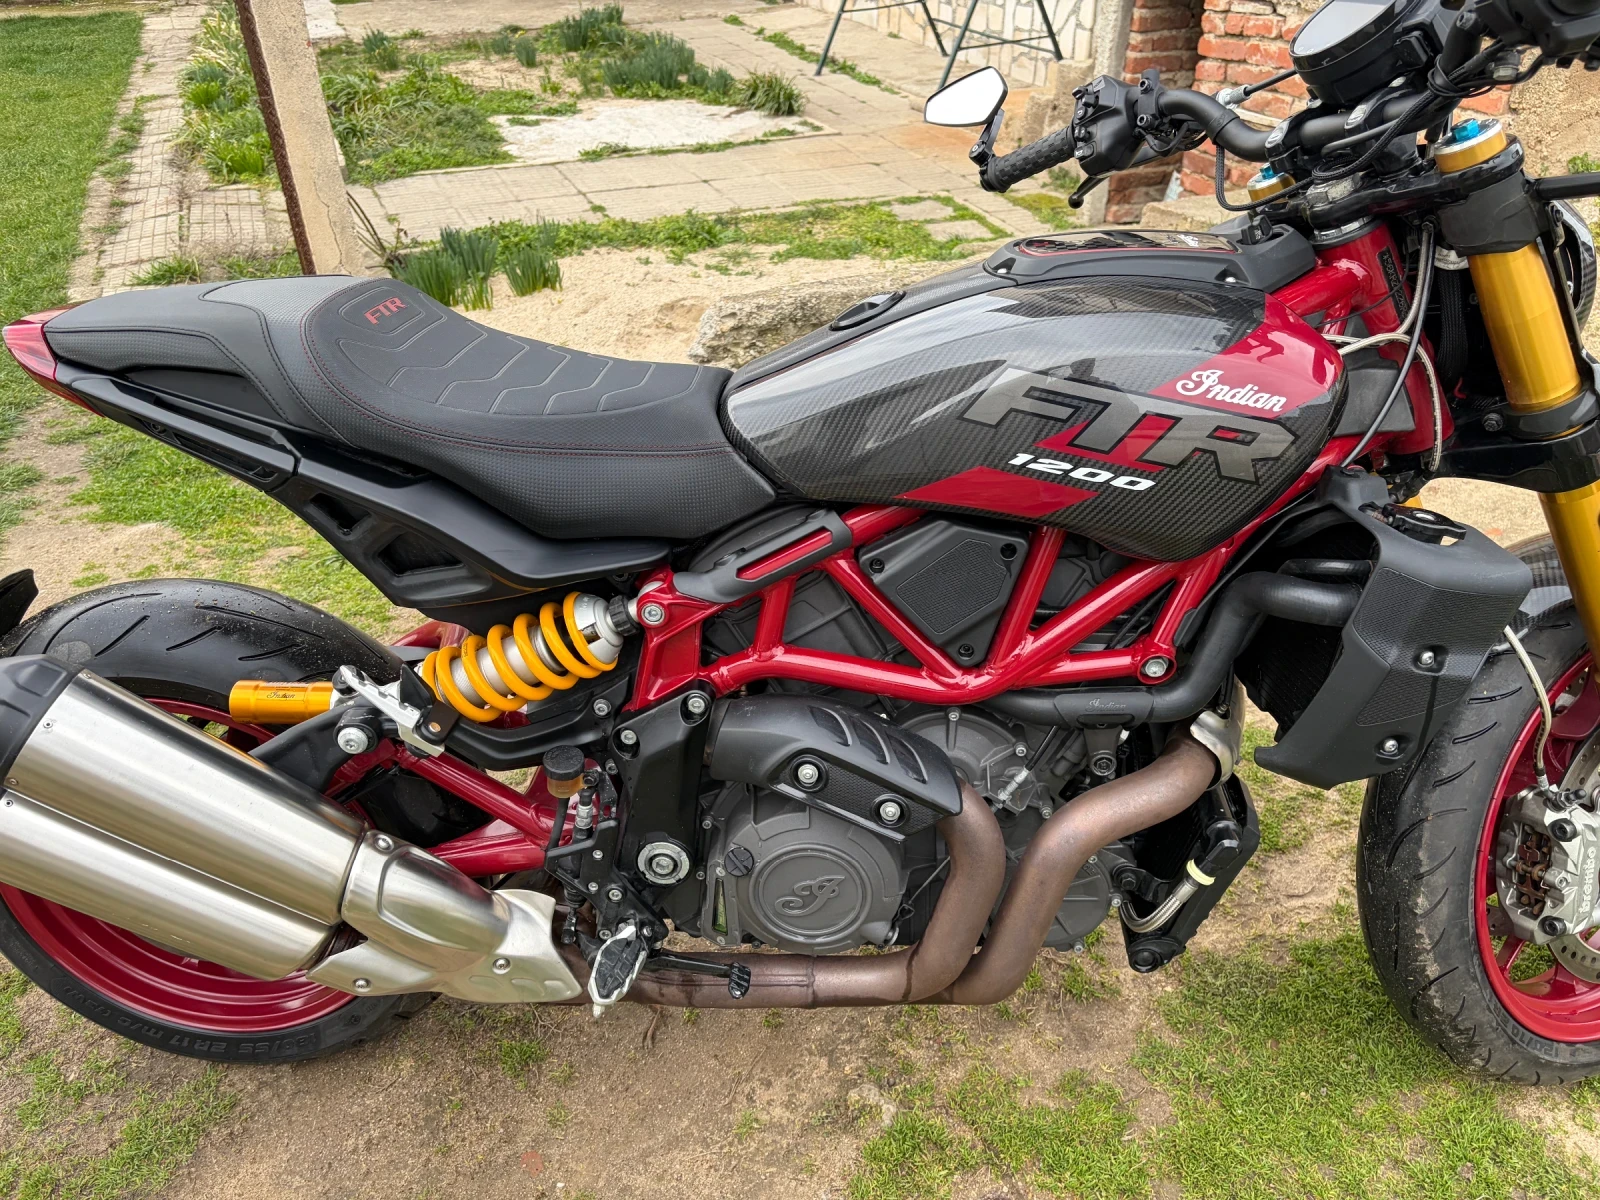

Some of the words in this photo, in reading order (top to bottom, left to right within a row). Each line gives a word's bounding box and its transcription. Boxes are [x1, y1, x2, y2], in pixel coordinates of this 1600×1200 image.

[363, 297, 408, 325] FTR
[1175, 368, 1288, 414] Indian
[957, 364, 1299, 485] FTR
[1007, 452, 1157, 492] 1200
[1085, 698, 1126, 712] Indian
[1580, 846, 1597, 914] brembo
